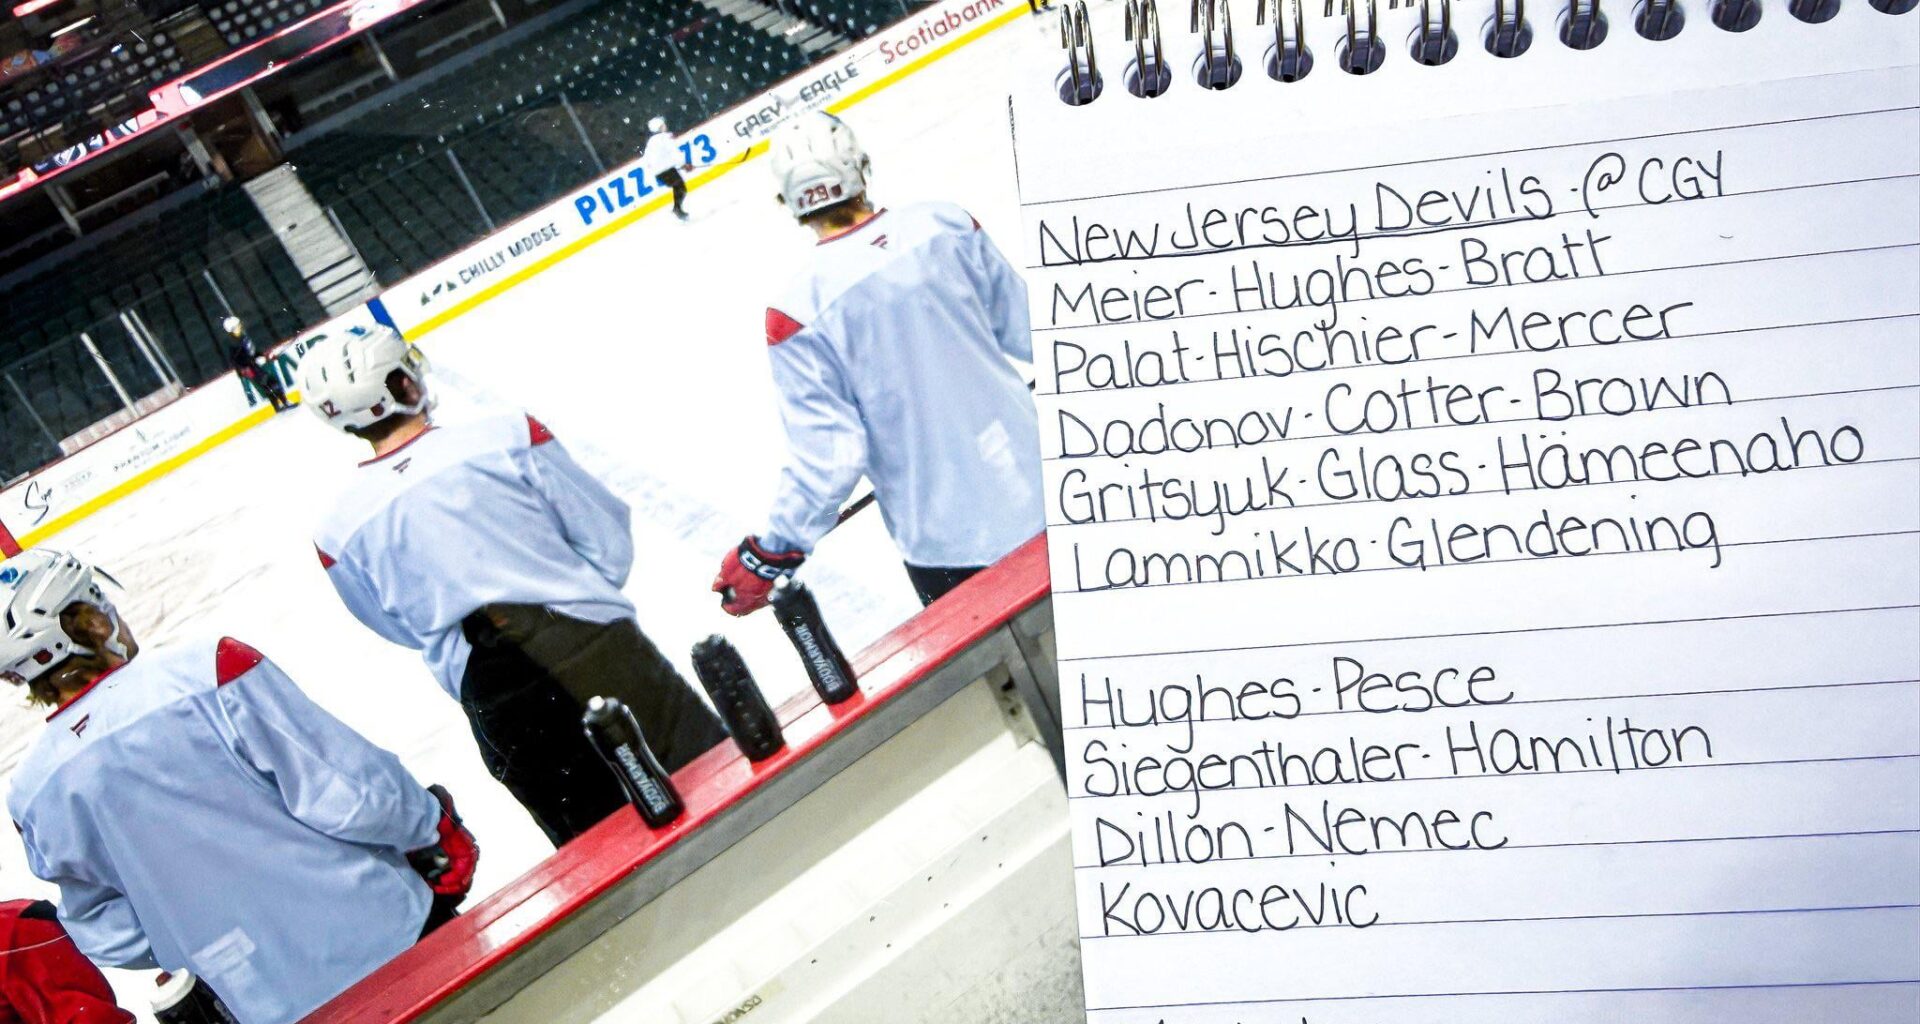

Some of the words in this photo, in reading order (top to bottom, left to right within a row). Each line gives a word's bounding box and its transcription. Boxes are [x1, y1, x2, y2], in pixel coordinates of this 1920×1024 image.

[733, 98, 782, 138] GREY
[799, 62, 859, 102] EAGLE
[575, 167, 667, 225] PIZZ
[678, 134, 716, 171] 73
[1172, 203, 1358, 258] Jersey
[1376, 168, 1553, 231] Devils
[1638, 150, 1723, 204] CGY
[458, 251, 506, 284] CHILLY
[507, 222, 561, 257] MOOSE
[795, 623, 843, 692] BODYARMOR
[615, 742, 668, 815] BODYARMOR
[1100, 861, 1379, 936] Kovacevic
